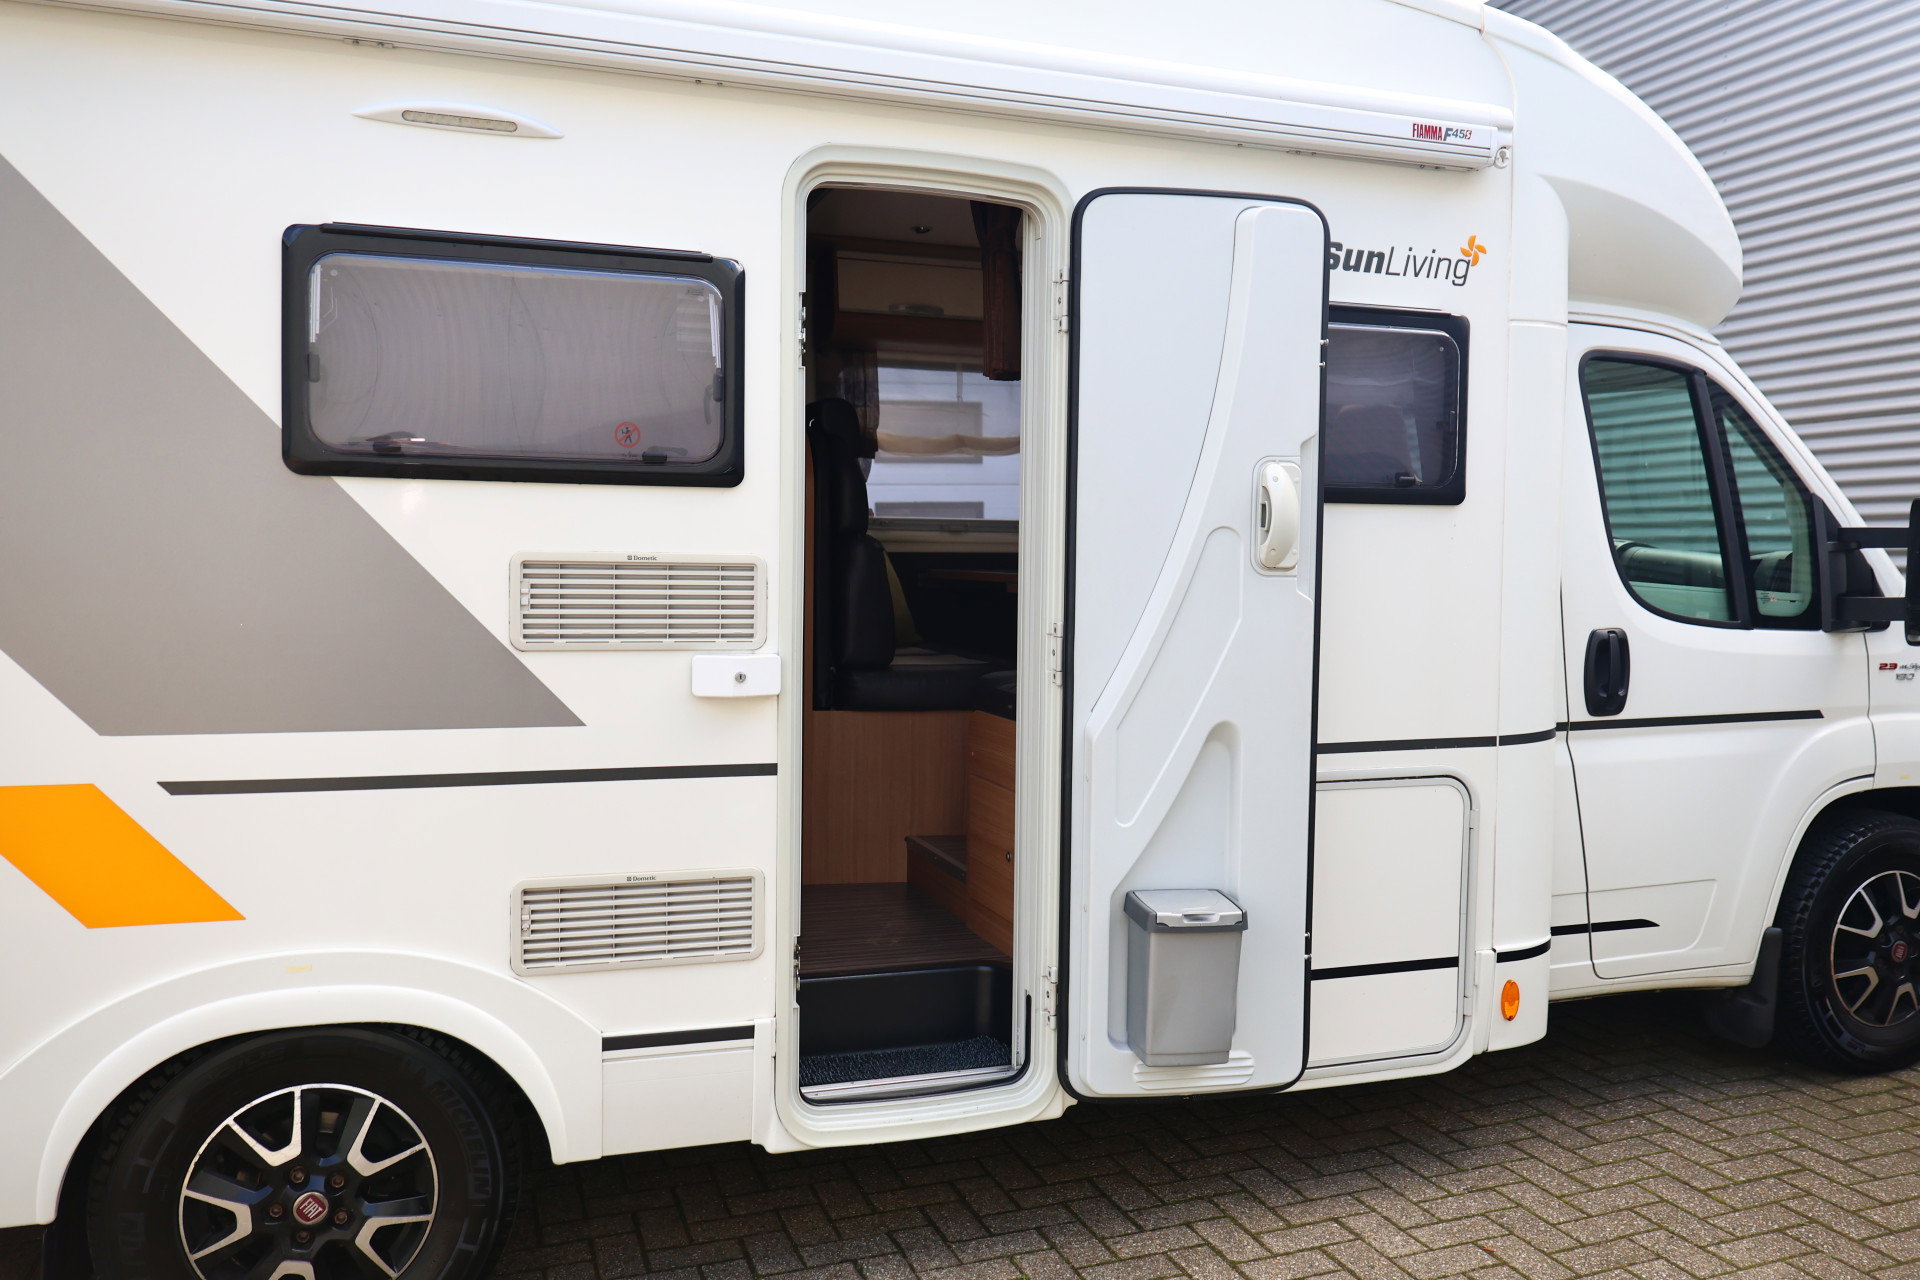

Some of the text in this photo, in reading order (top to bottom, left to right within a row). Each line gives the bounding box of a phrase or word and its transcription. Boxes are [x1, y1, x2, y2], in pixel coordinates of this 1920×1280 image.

[1412, 123, 1443, 141] FIAMMA
[1329, 241, 1471, 286] SunLiving
[299, 1197, 323, 1219] FIAT
